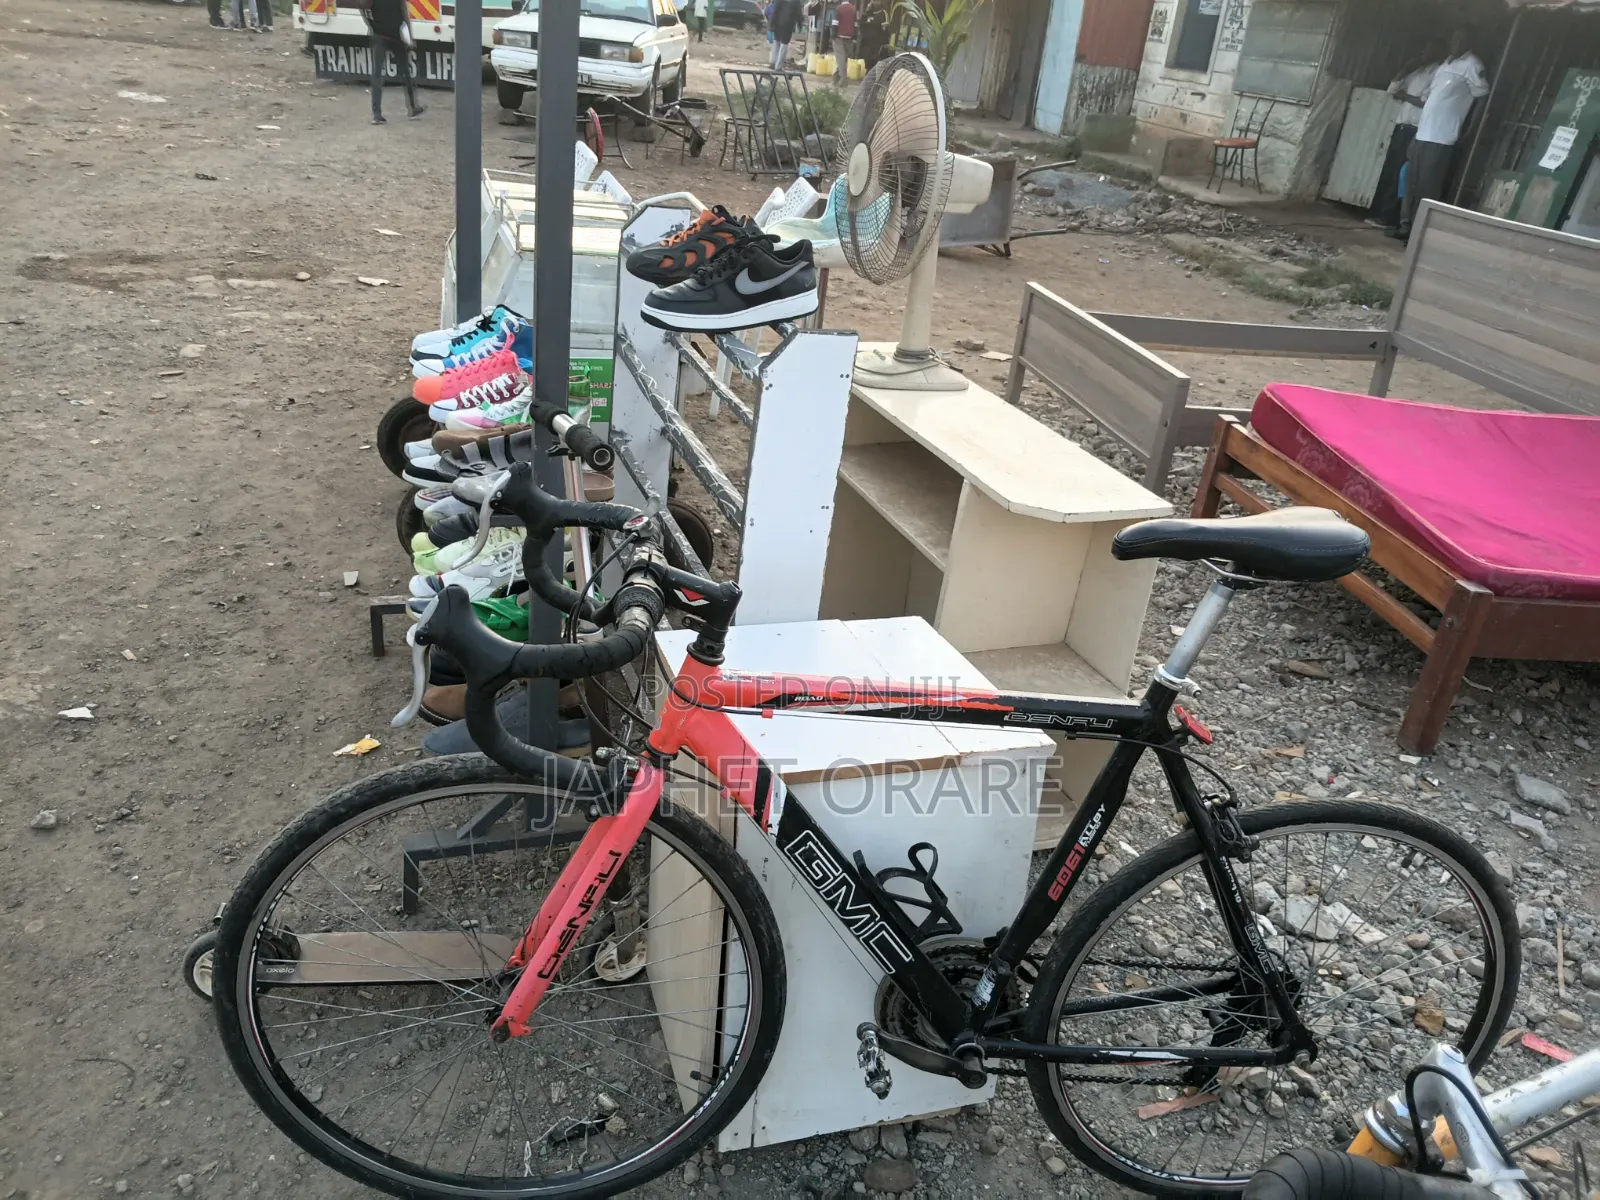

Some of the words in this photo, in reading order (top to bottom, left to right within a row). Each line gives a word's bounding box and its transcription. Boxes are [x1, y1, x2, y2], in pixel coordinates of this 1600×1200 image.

[314, 45, 397, 77] TRAINIG
[1047, 842, 1086, 901] 6061
[1079, 803, 1106, 847] ALLOY
[537, 849, 622, 979] DENALI
[784, 830, 913, 974] GMC
[1244, 922, 1275, 974] GMC
